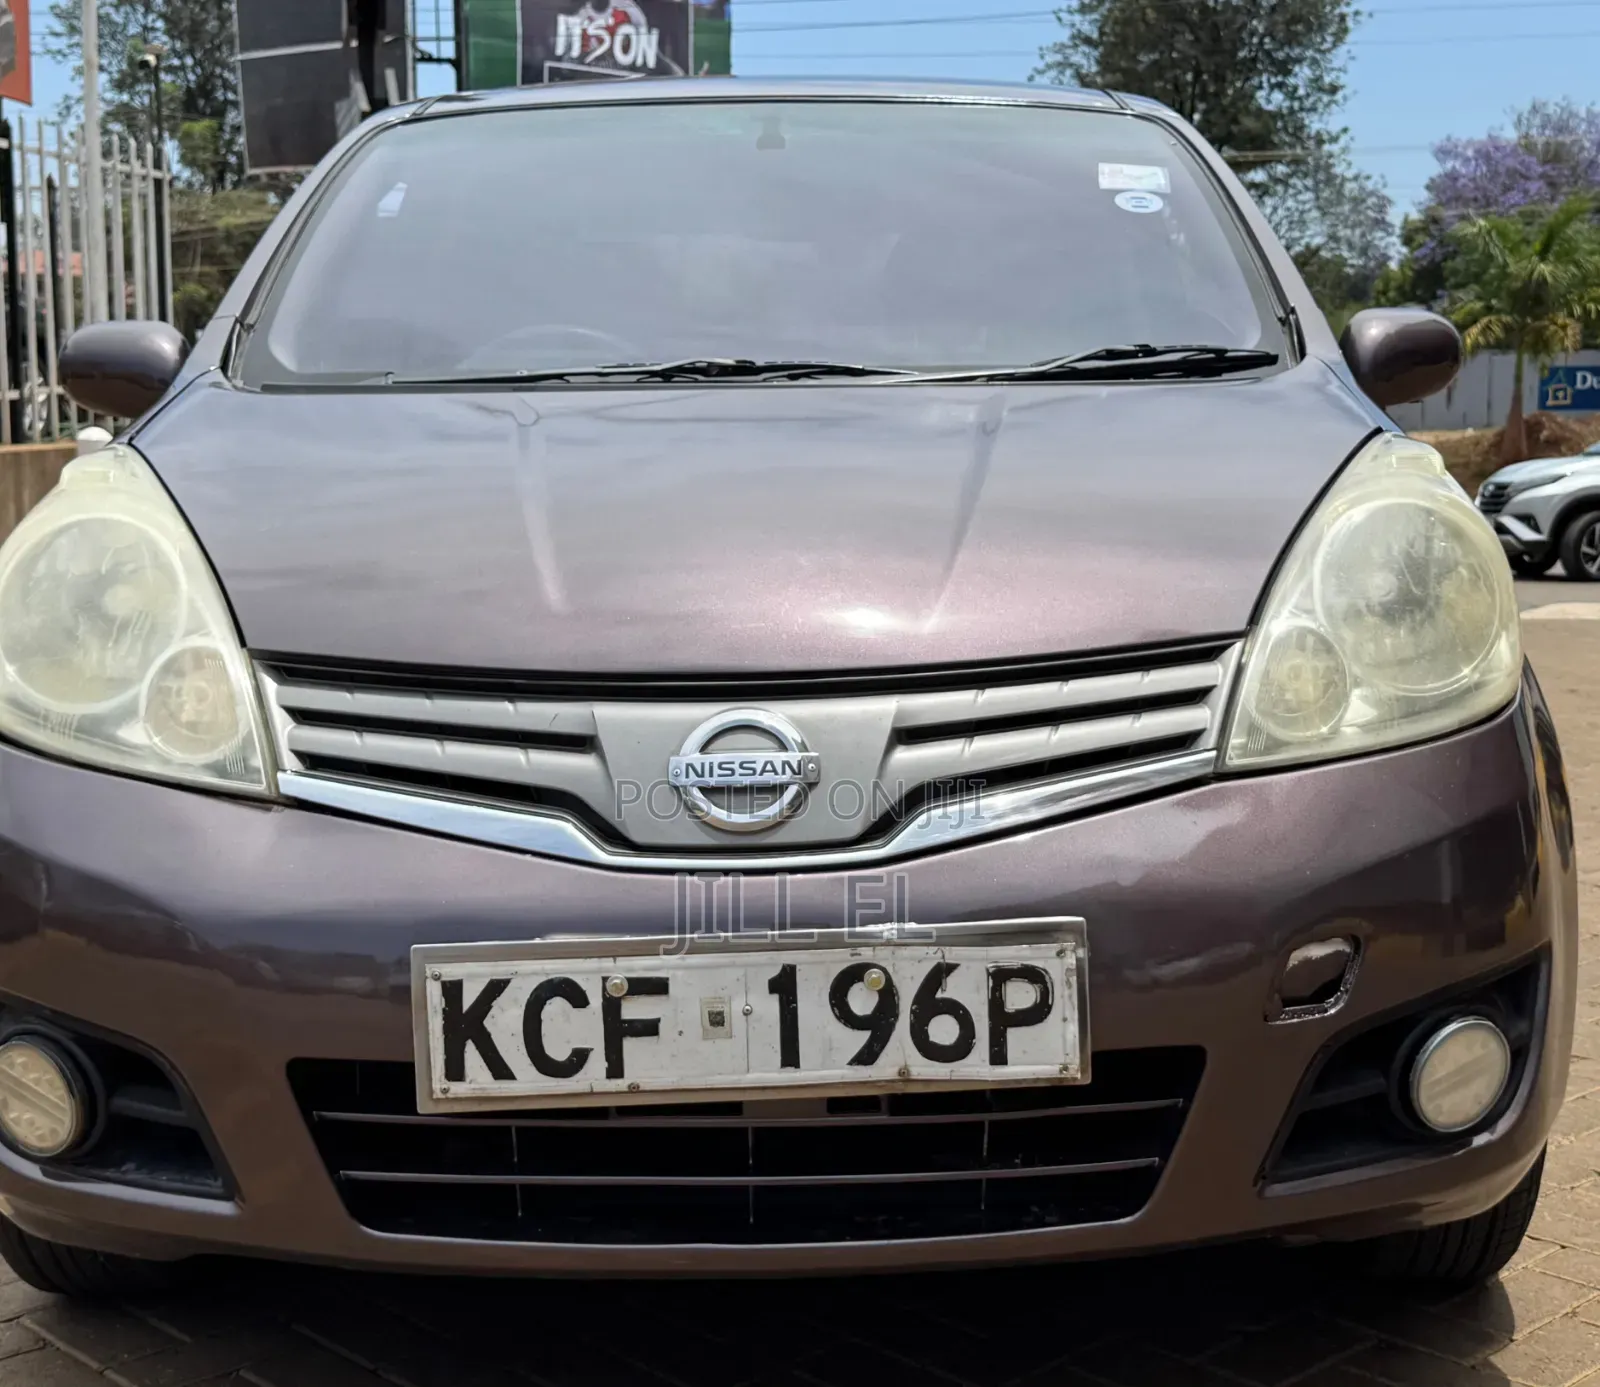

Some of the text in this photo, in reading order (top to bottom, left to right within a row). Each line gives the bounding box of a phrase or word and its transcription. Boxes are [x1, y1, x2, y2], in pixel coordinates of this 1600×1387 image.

[613, 25, 660, 69] ON
[684, 759, 802, 779] NISSAN
[441, 961, 1054, 1082] KCF 196P
